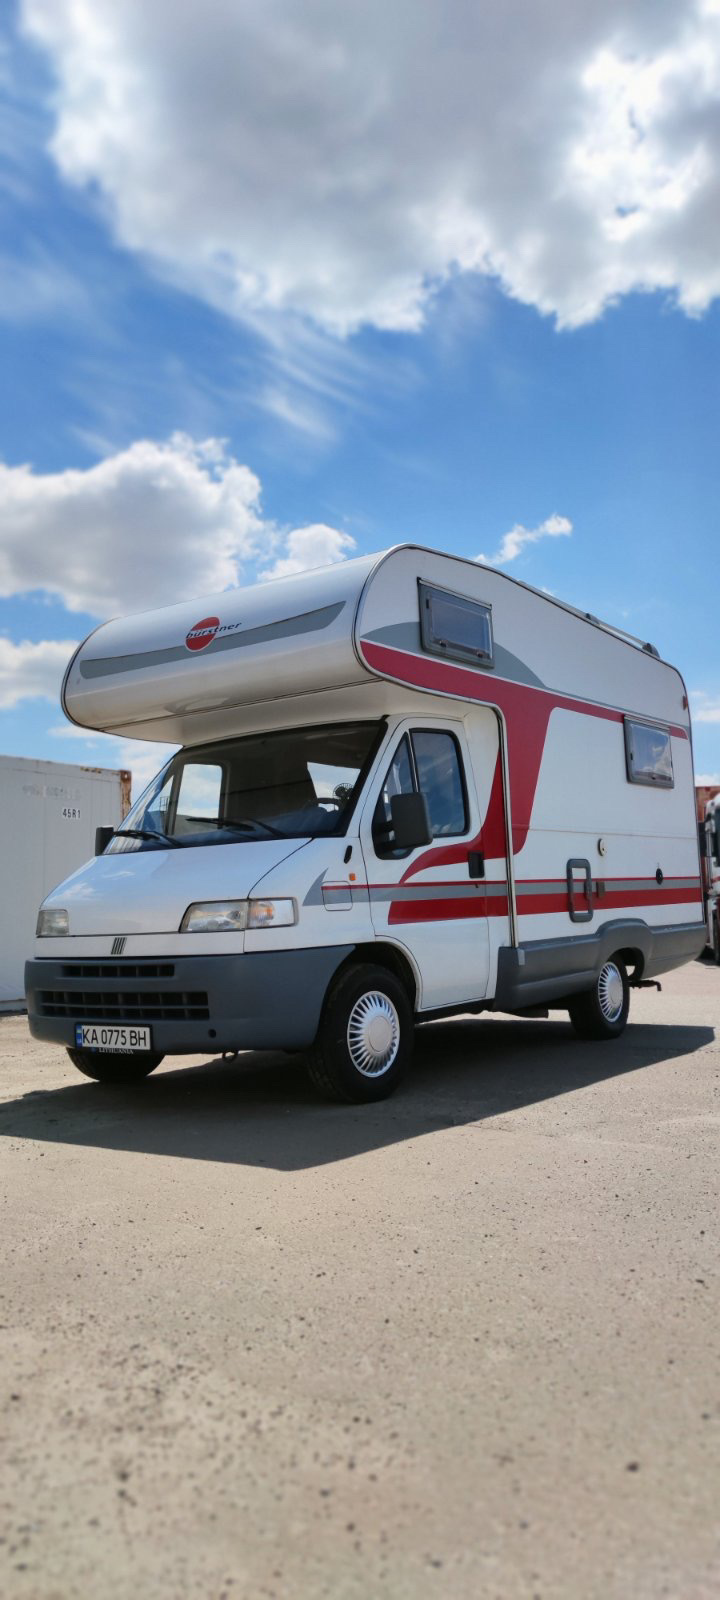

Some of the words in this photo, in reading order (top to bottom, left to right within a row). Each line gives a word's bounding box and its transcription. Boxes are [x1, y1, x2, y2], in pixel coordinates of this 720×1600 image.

[62, 808, 81, 819] 45R1
[82, 1028, 99, 1044] KA
[101, 1029, 127, 1046] 0775
[129, 1030, 147, 1047] BH
